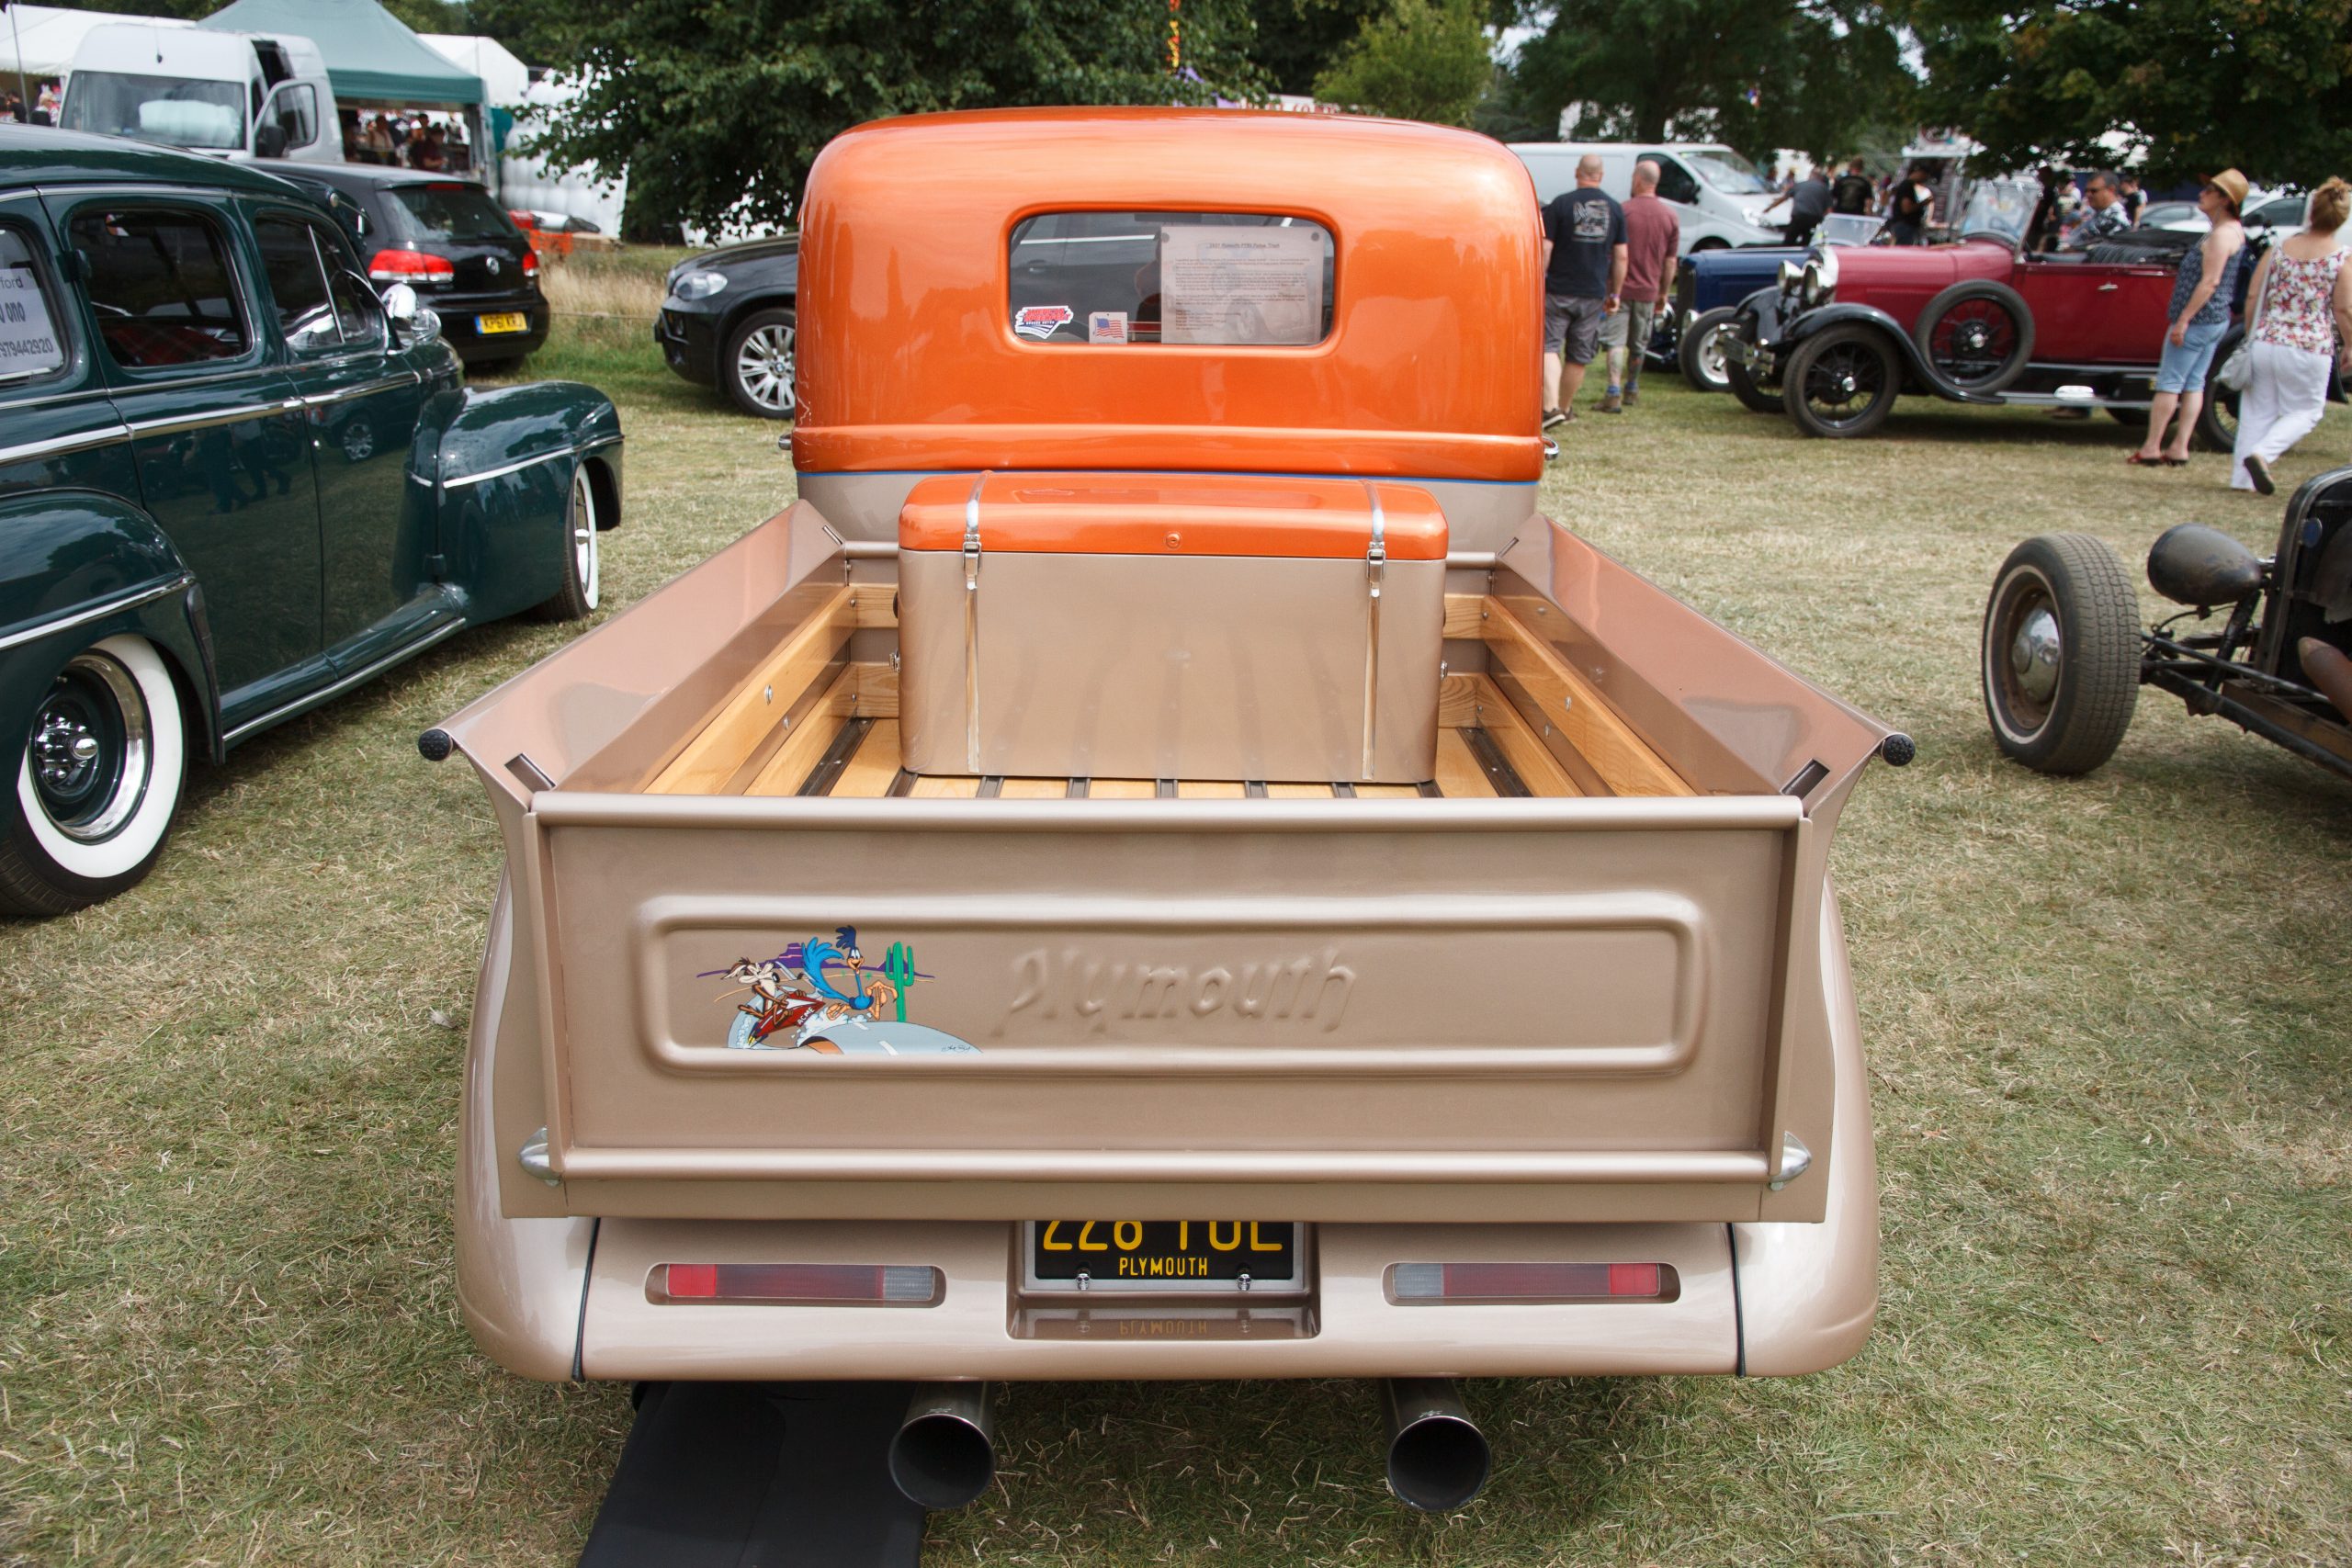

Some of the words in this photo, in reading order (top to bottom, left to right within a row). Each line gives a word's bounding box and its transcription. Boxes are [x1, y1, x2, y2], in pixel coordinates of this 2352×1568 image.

[0, 338, 54, 357] 979442920
[989, 948, 1356, 1038] Plymouth
[797, 1007, 816, 1025] ACME
[1119, 1257, 1208, 1277] PLYMOUTH
